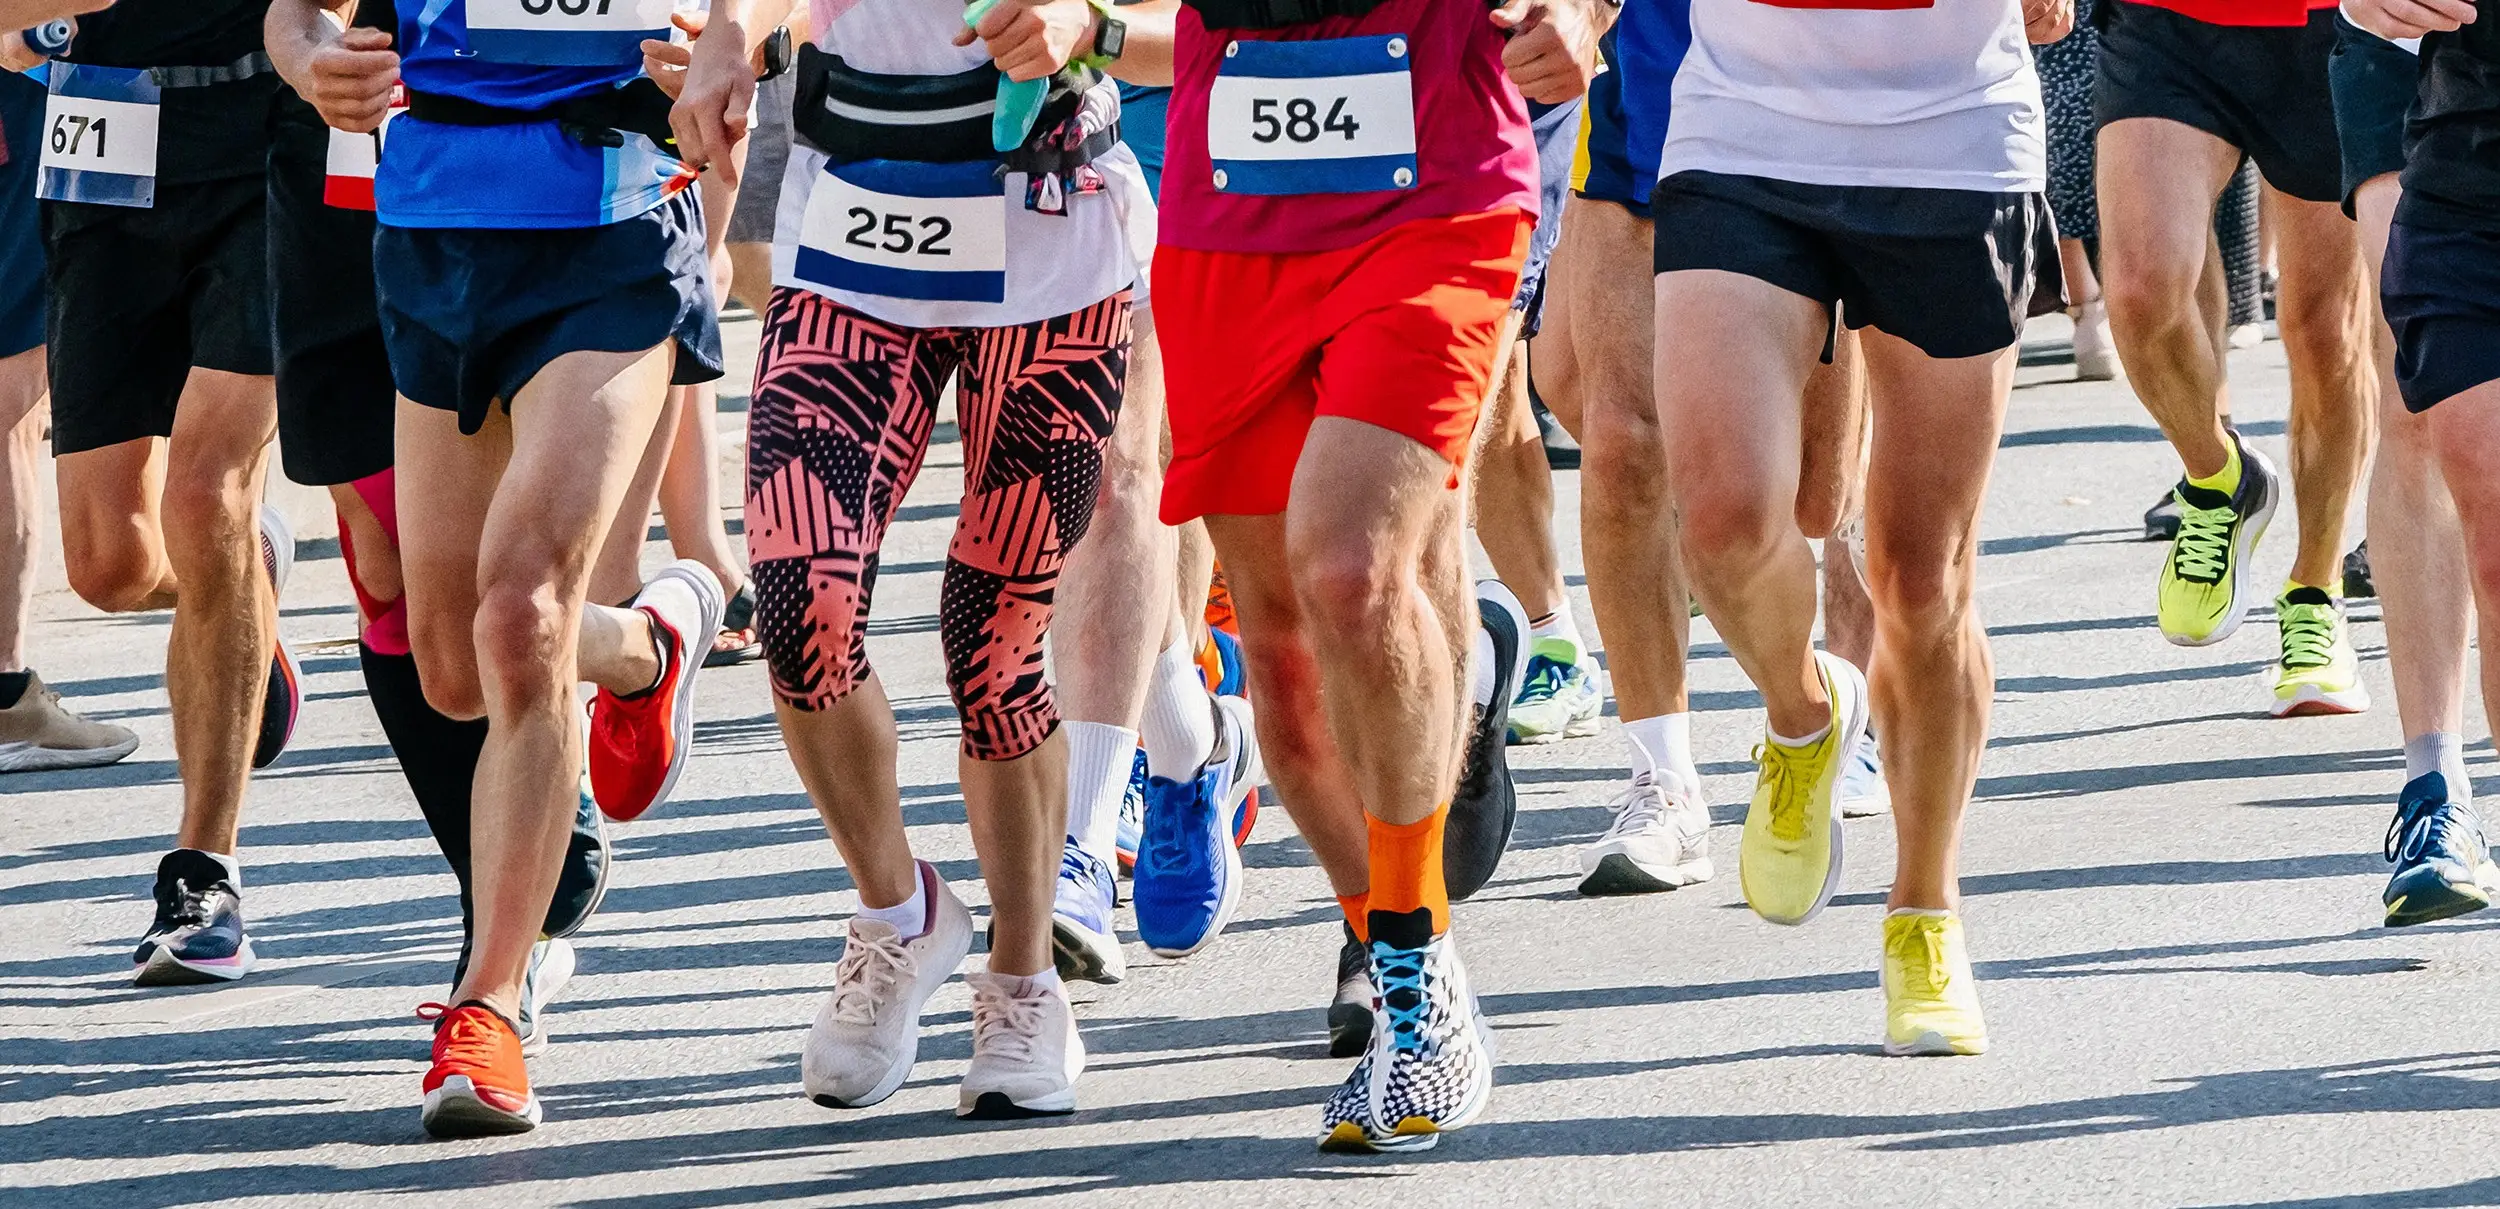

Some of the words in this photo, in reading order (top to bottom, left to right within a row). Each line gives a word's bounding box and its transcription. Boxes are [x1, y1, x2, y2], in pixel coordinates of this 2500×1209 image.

[51, 113, 106, 158] 671
[1251, 96, 1360, 143] 584
[845, 206, 952, 256] 252
